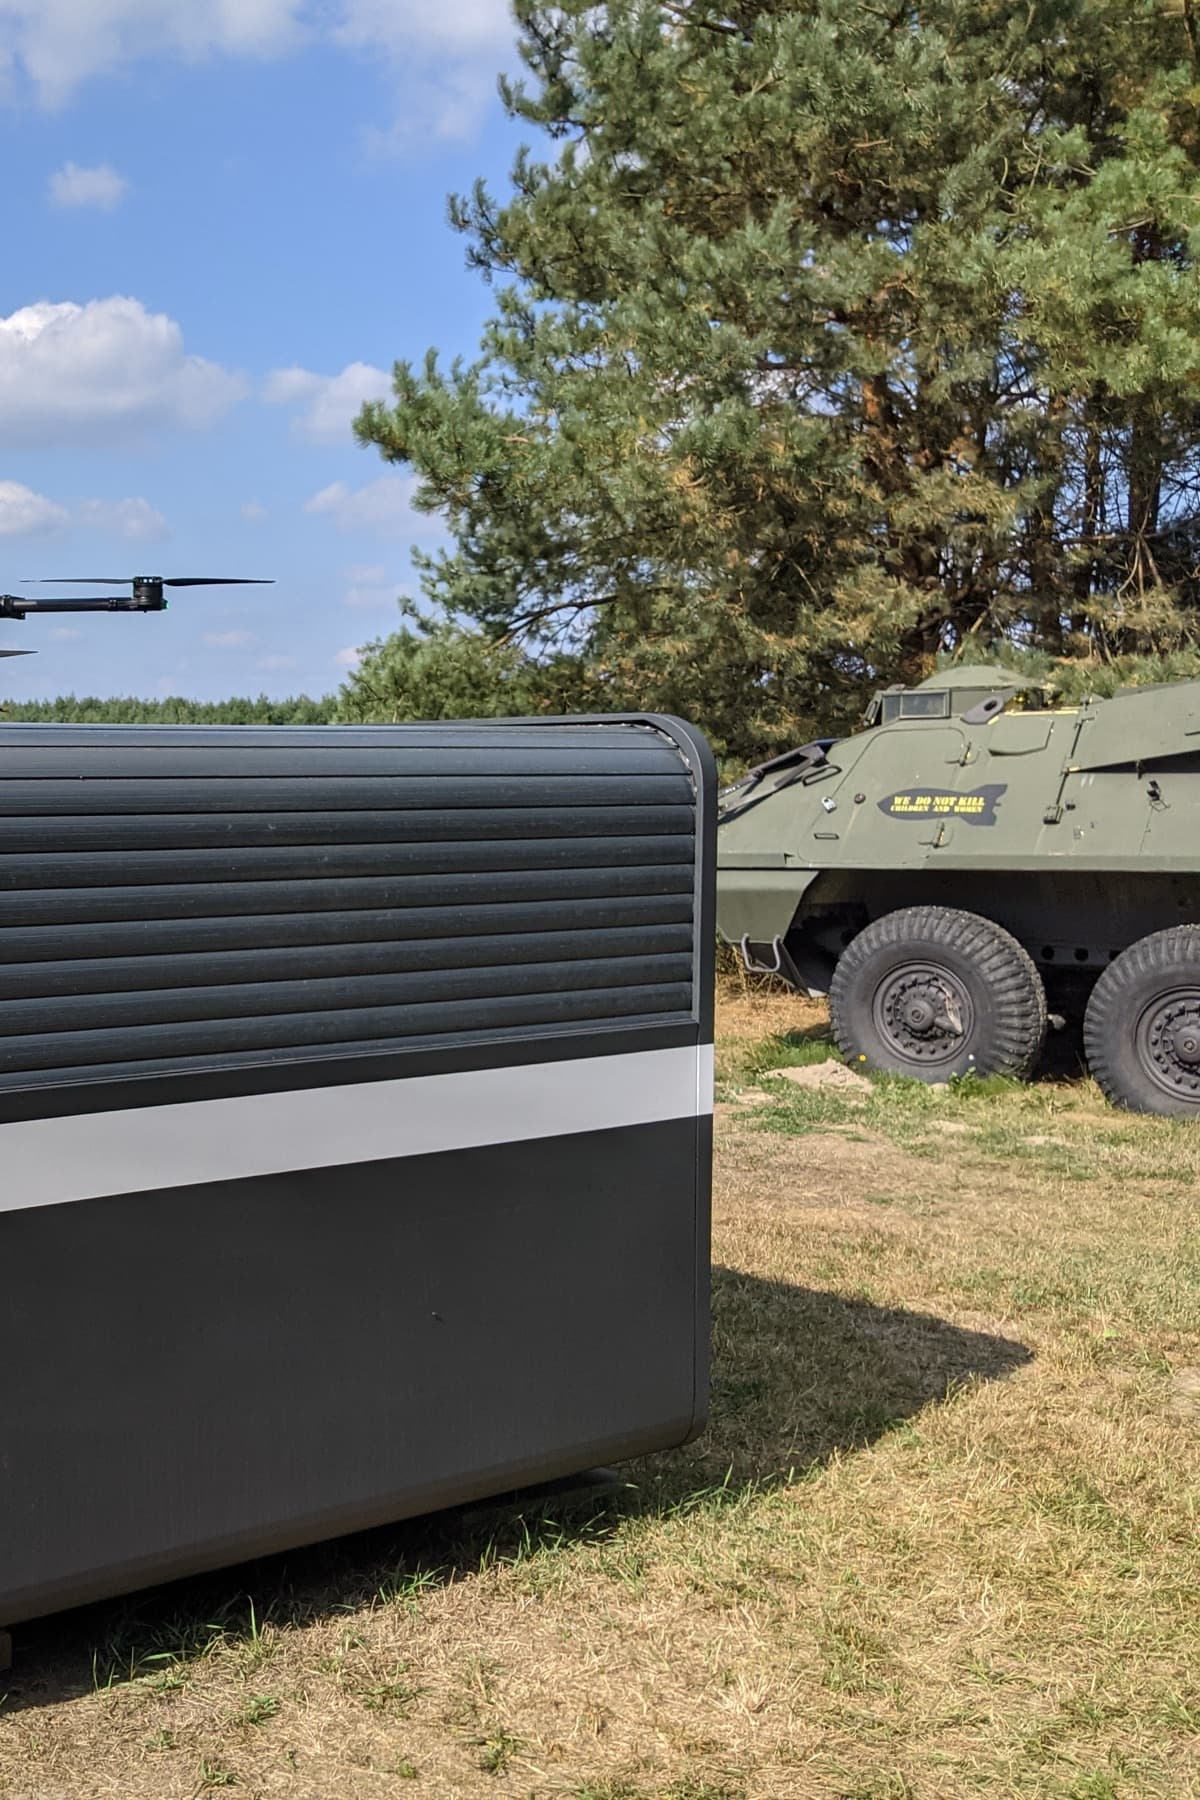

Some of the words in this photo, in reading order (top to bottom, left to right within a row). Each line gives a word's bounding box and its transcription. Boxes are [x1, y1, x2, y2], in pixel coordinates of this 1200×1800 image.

[894, 796, 911, 805] WE
[915, 796, 931, 805] DO
[933, 796, 957, 806] NOT
[958, 796, 985, 806] KILL
